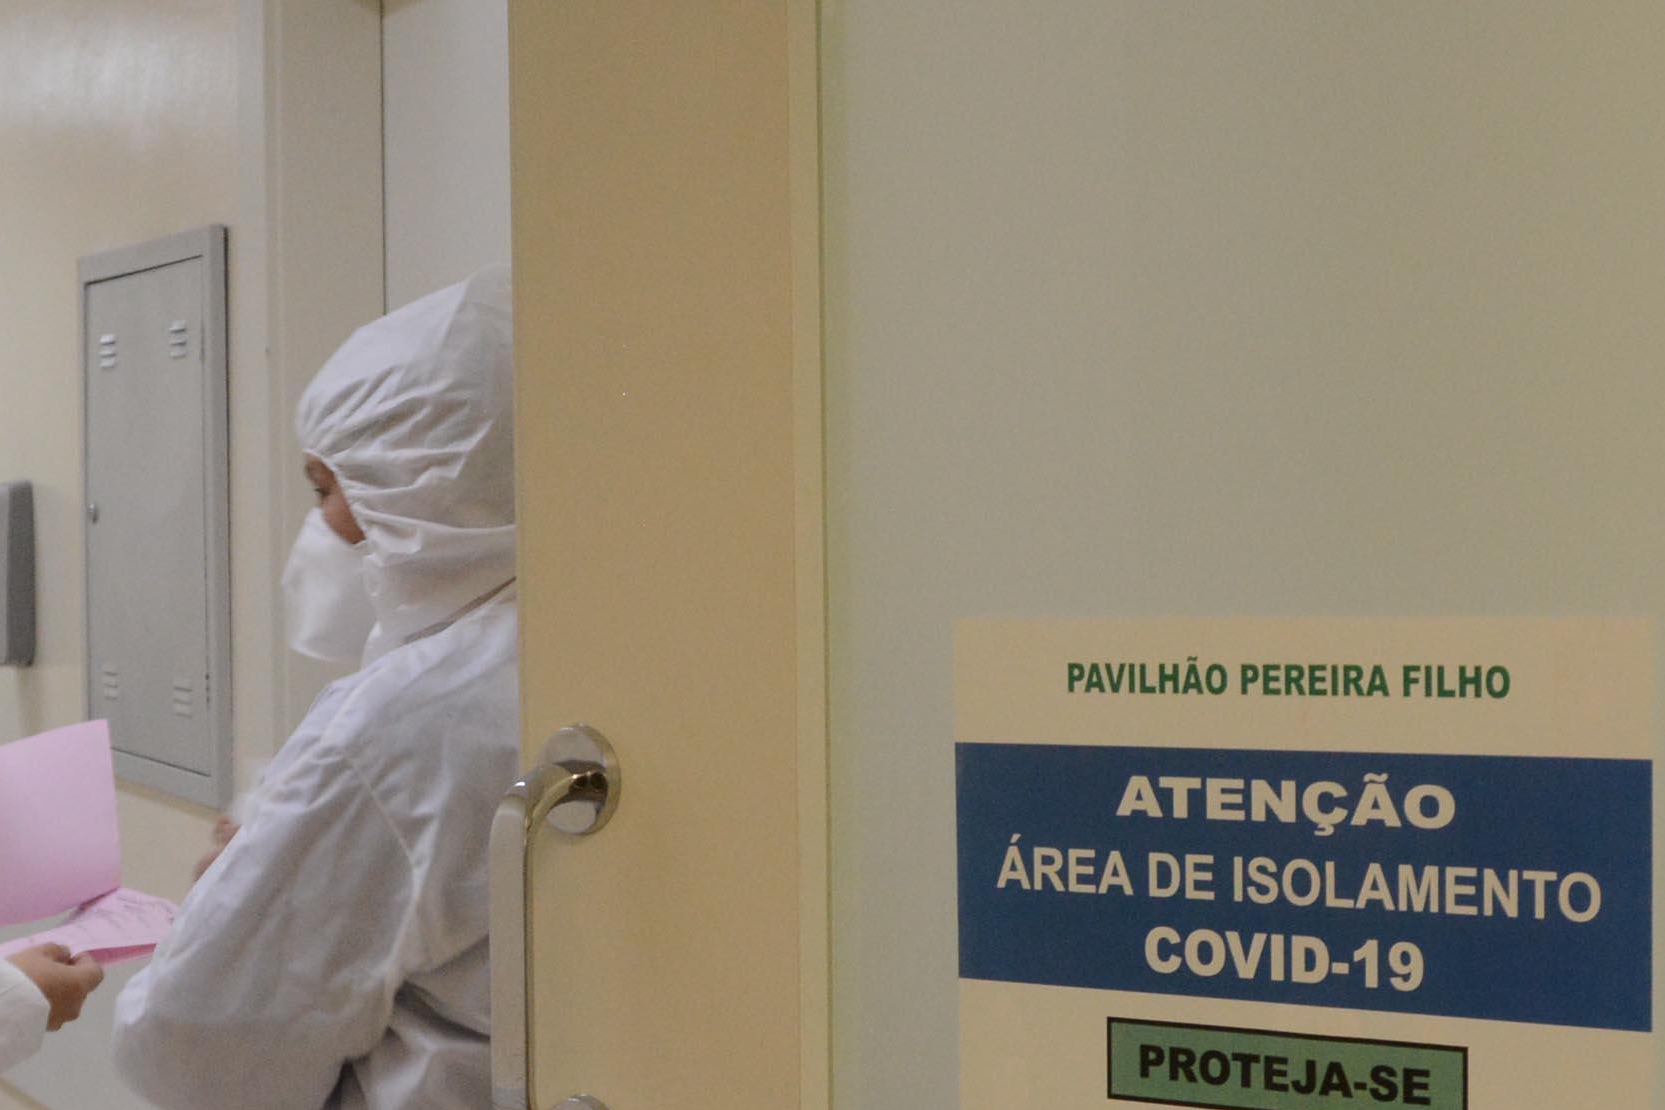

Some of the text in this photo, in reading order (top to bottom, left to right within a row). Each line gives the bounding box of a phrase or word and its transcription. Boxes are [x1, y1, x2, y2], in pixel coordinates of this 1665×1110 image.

[1067, 656, 1511, 699] PAVILHÃO PEREIRA FILHO
[1115, 772, 1456, 837] ATENÇÃO
[996, 833, 1602, 923] ÁREA DE ISOLAMENTO
[1144, 926, 1424, 992] COVID-19
[1138, 1043, 1432, 1106] PROTEJA-SE
